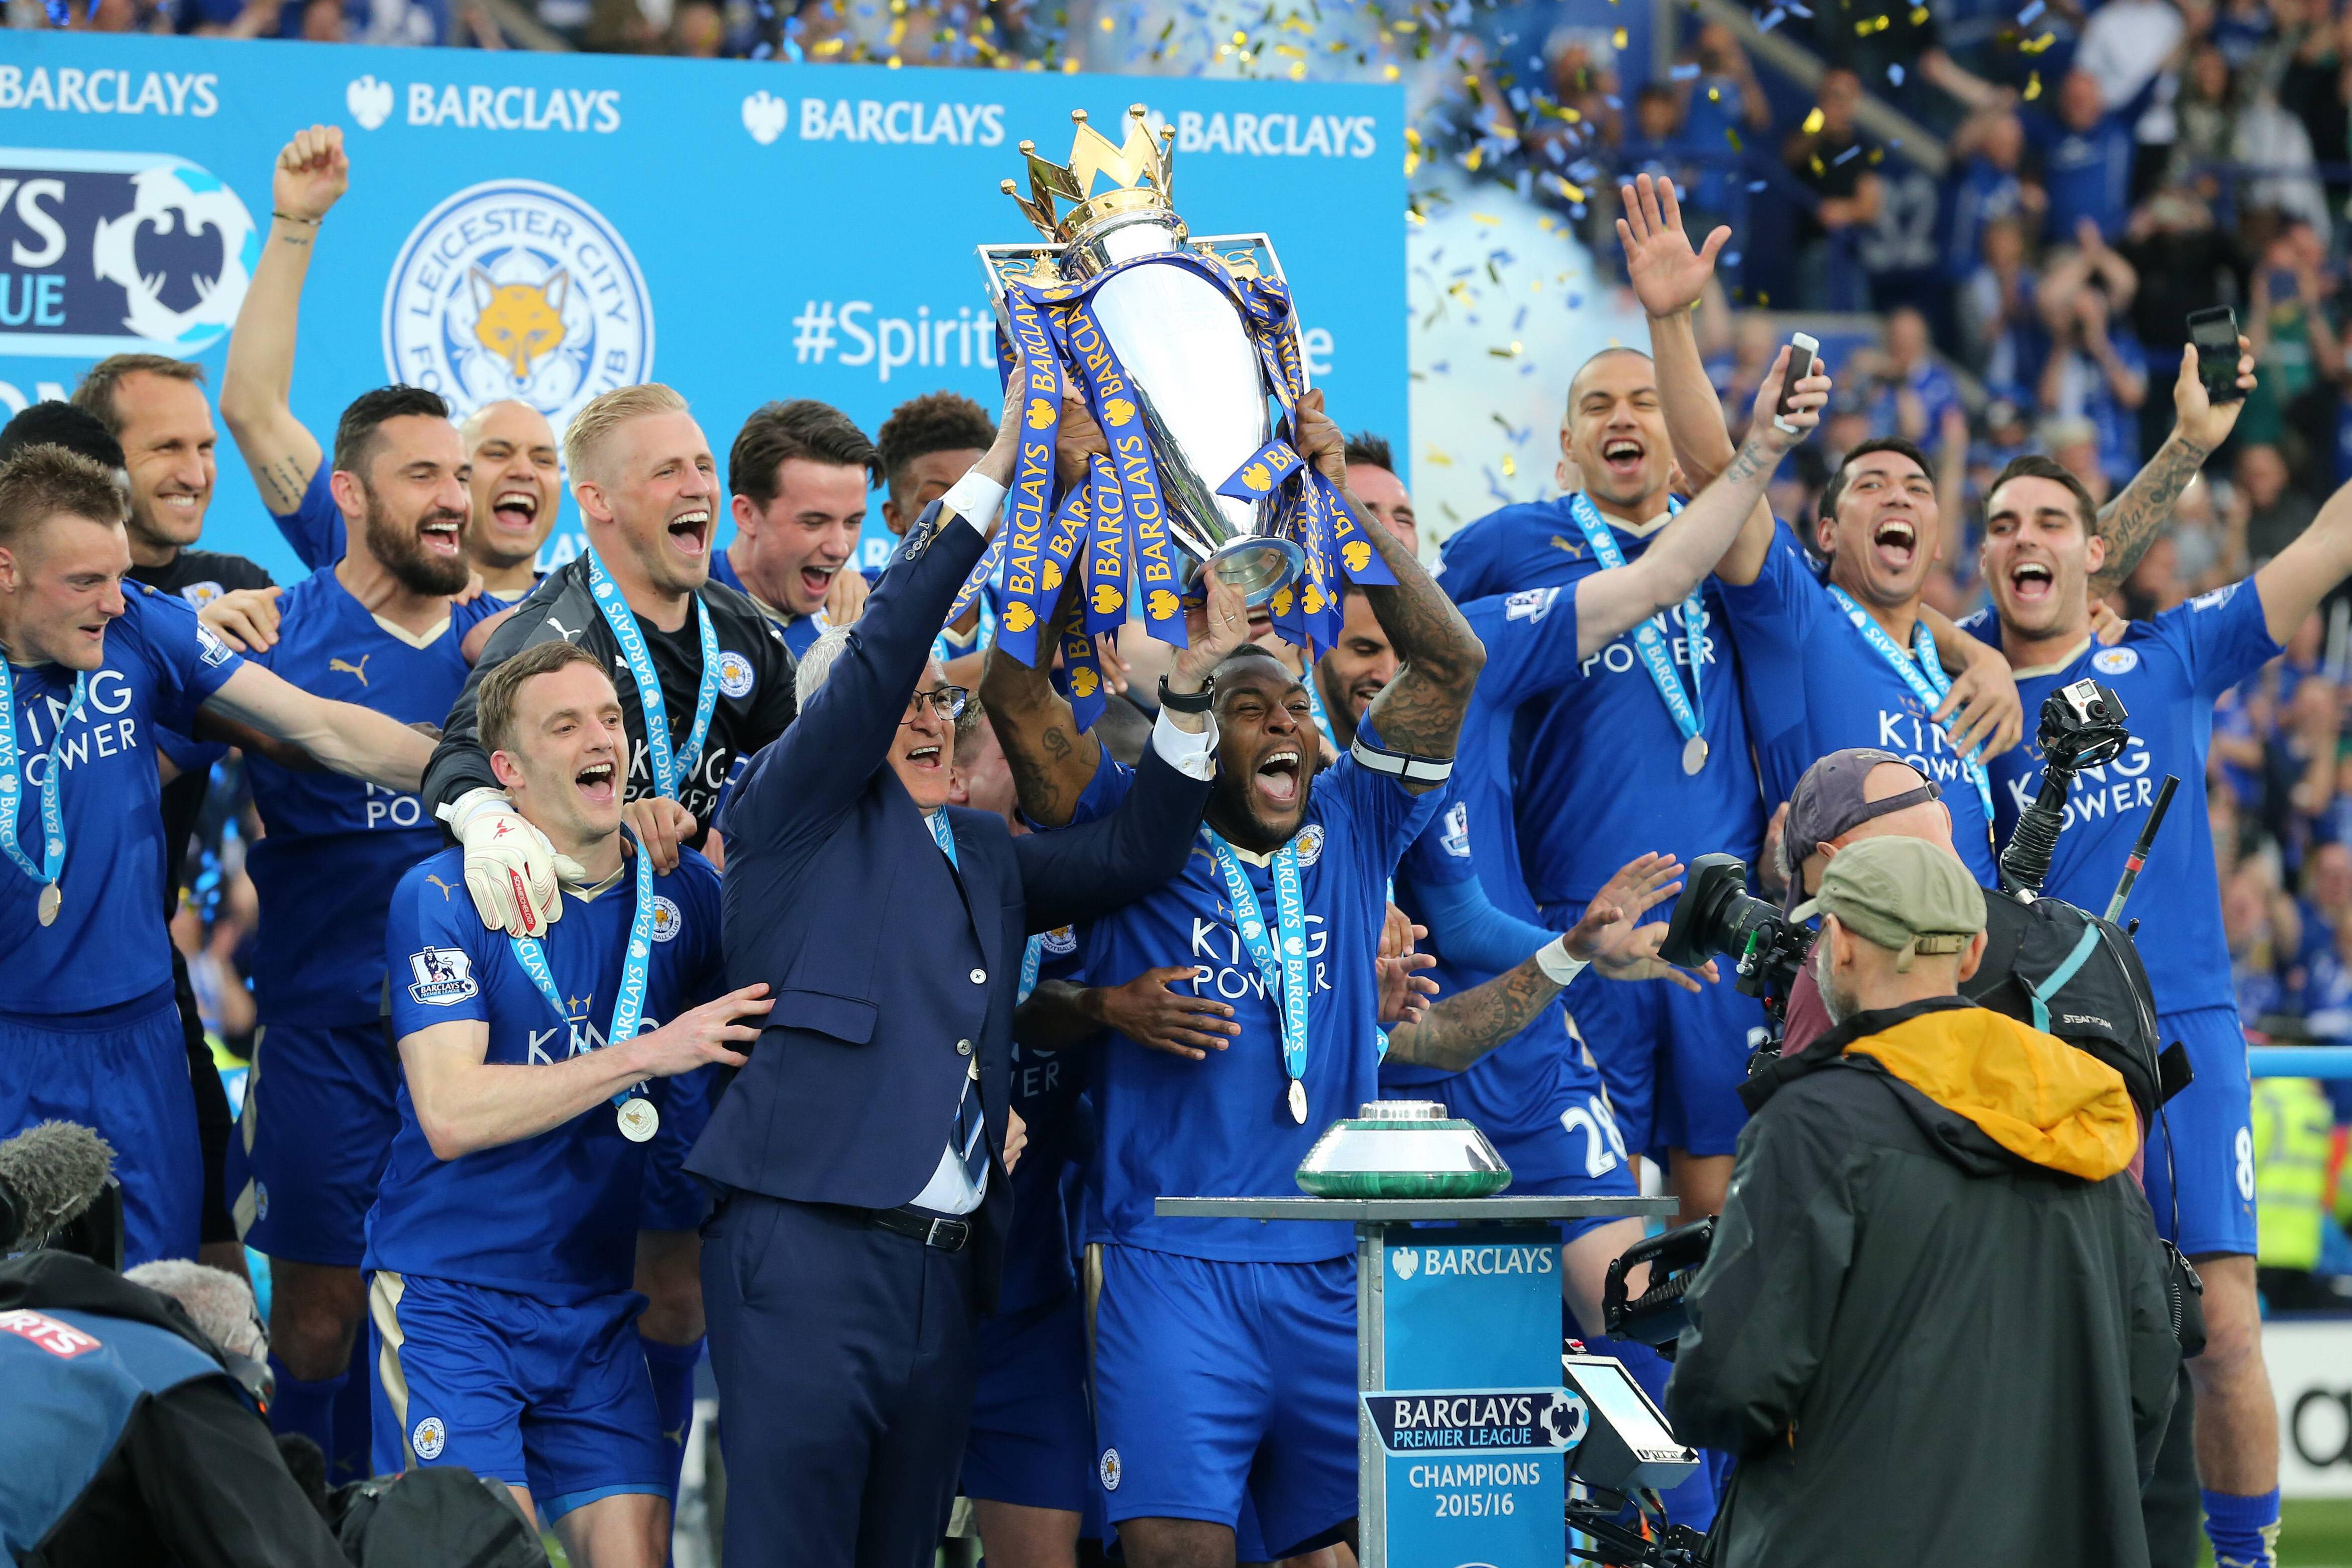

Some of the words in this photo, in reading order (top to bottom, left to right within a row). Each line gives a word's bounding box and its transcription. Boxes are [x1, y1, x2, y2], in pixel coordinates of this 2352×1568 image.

[0, 65, 219, 117] BARCLAYS
[407, 83, 621, 133] BARCLAYS
[800, 98, 1005, 147] BARCLAYS
[1177, 110, 1377, 158] BARCLAYS
[410, 208, 574, 317] LEICESTER
[577, 241, 628, 322] CITY
[1081, 251, 1220, 293] BARCLAYS
[1067, 302, 1125, 398] BARCLA
[1009, 442, 1050, 596] BARCLAYS
[1093, 452, 1124, 578] BARCLAY
[1115, 435, 1172, 582] BARCLAYS
[606, 602, 655, 686] BARCLAYS
[699, 626, 721, 714] BARCLAYS
[1864, 627, 1928, 692] BARCLAYS
[27, 670, 132, 747] ING
[1647, 645, 1689, 721] BARCLAYS
[25, 718, 137, 787] OWER
[1879, 709, 1958, 754] KIN
[513, 875, 534, 926] SCHMEICHELOGY
[636, 852, 651, 939] BARCLAYS
[1216, 846, 1255, 919] BARCLAYS
[1276, 846, 1300, 929] BARCLAYS
[668, 903, 679, 917] CITY
[668, 920, 680, 937] CLUB
[517, 936, 552, 993] RCLAYS
[1041, 937, 1074, 952] FOOTBALL
[421, 982, 460, 994] BARCLAYS
[1193, 961, 1331, 1000] POWR
[1286, 959, 1305, 1052] BARCLAYS
[1560, 1095, 1629, 1179] 28
[1424, 1247, 1553, 1276] BARCLAYS
[1393, 1428, 1465, 1448] PREMIER
[1469, 1427, 1532, 1446] LEAGUE
[1394, 1397, 1532, 1429] BARCLAYS
[1409, 1463, 1541, 1489] CHAMPIONS
[1435, 1493, 1515, 1517] 2015/16
